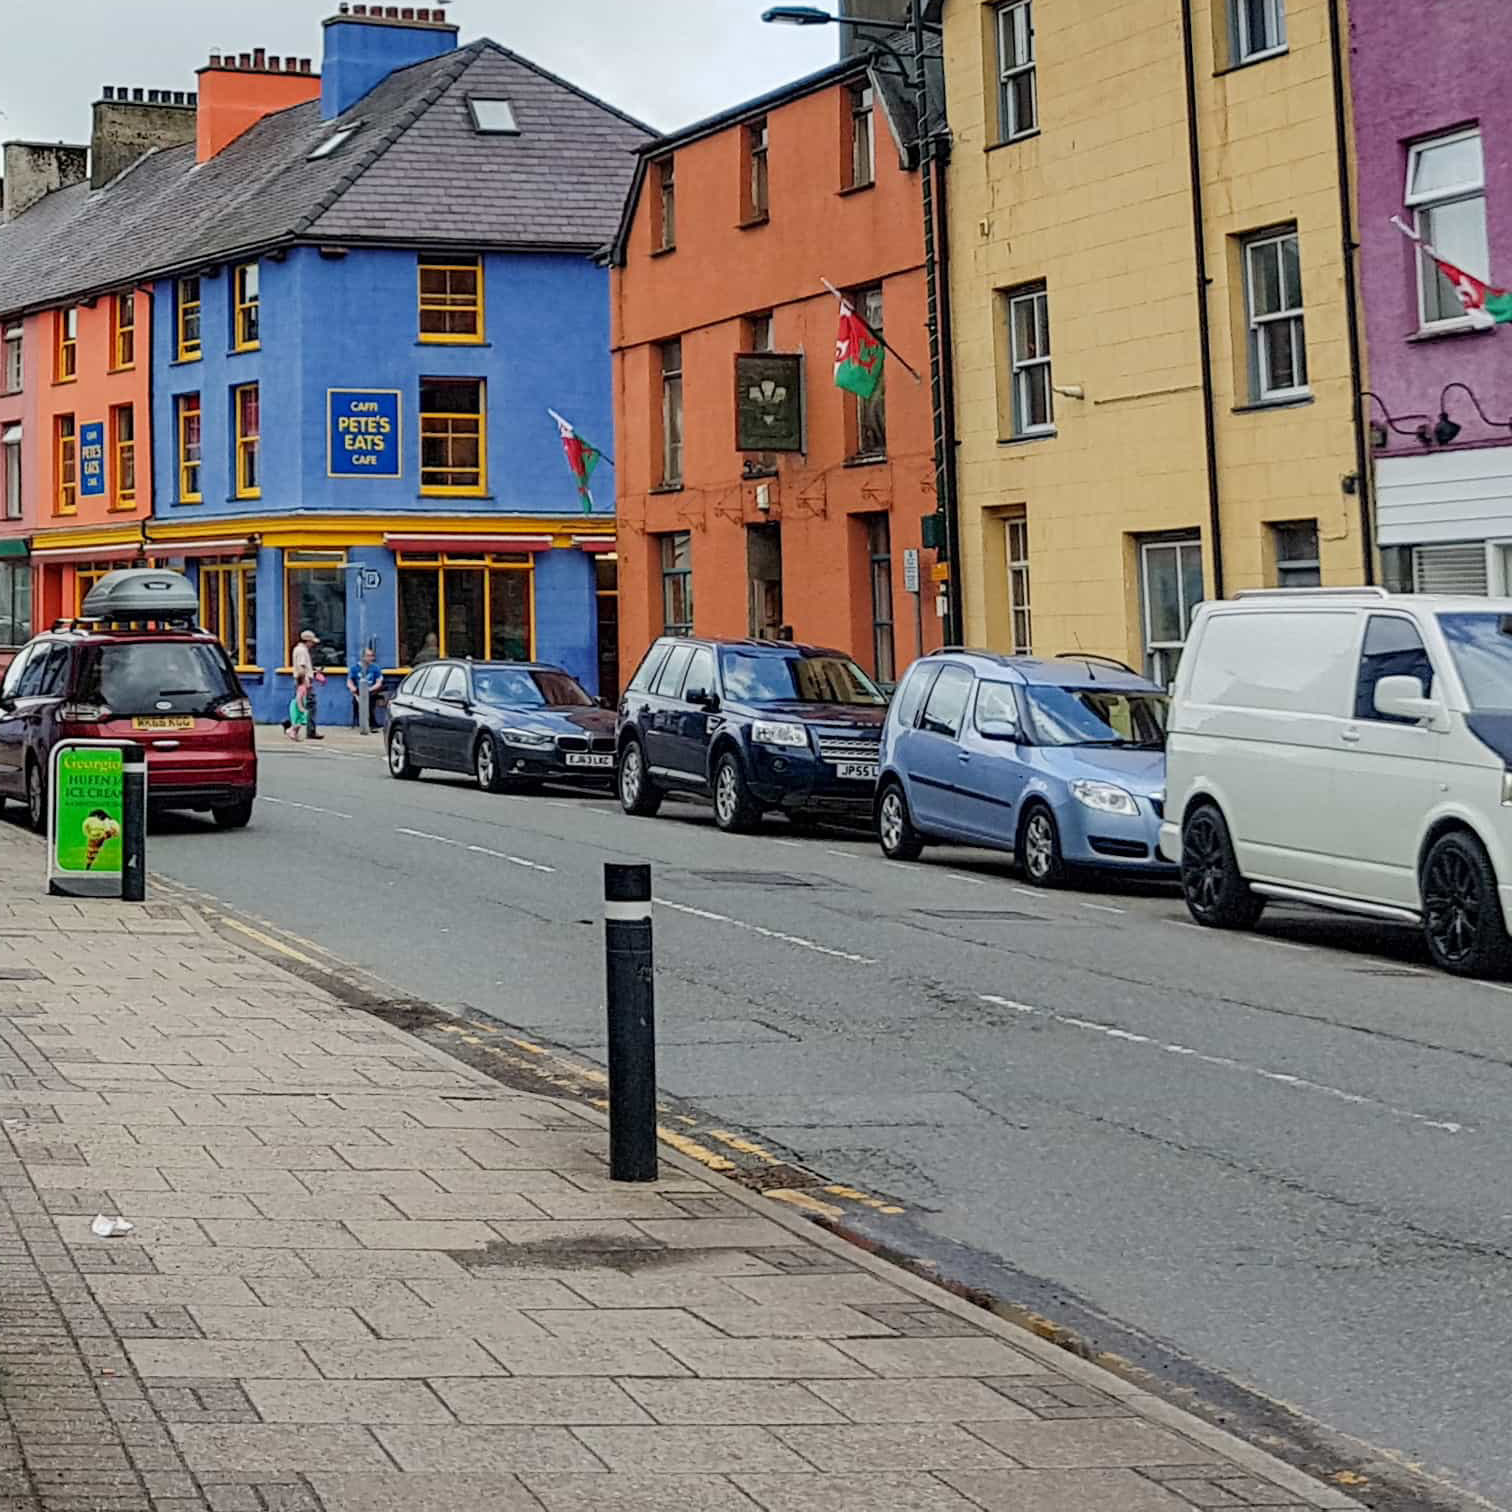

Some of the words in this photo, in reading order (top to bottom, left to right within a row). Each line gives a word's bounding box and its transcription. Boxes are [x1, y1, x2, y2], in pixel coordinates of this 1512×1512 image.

[338, 415, 391, 433] PETE'S
[344, 434, 385, 450] EATS
[351, 454, 377, 465] CAFE
[64, 755, 121, 772] Georgio
[841, 765, 870, 777] JP55
[88, 788, 122, 799] CREA
